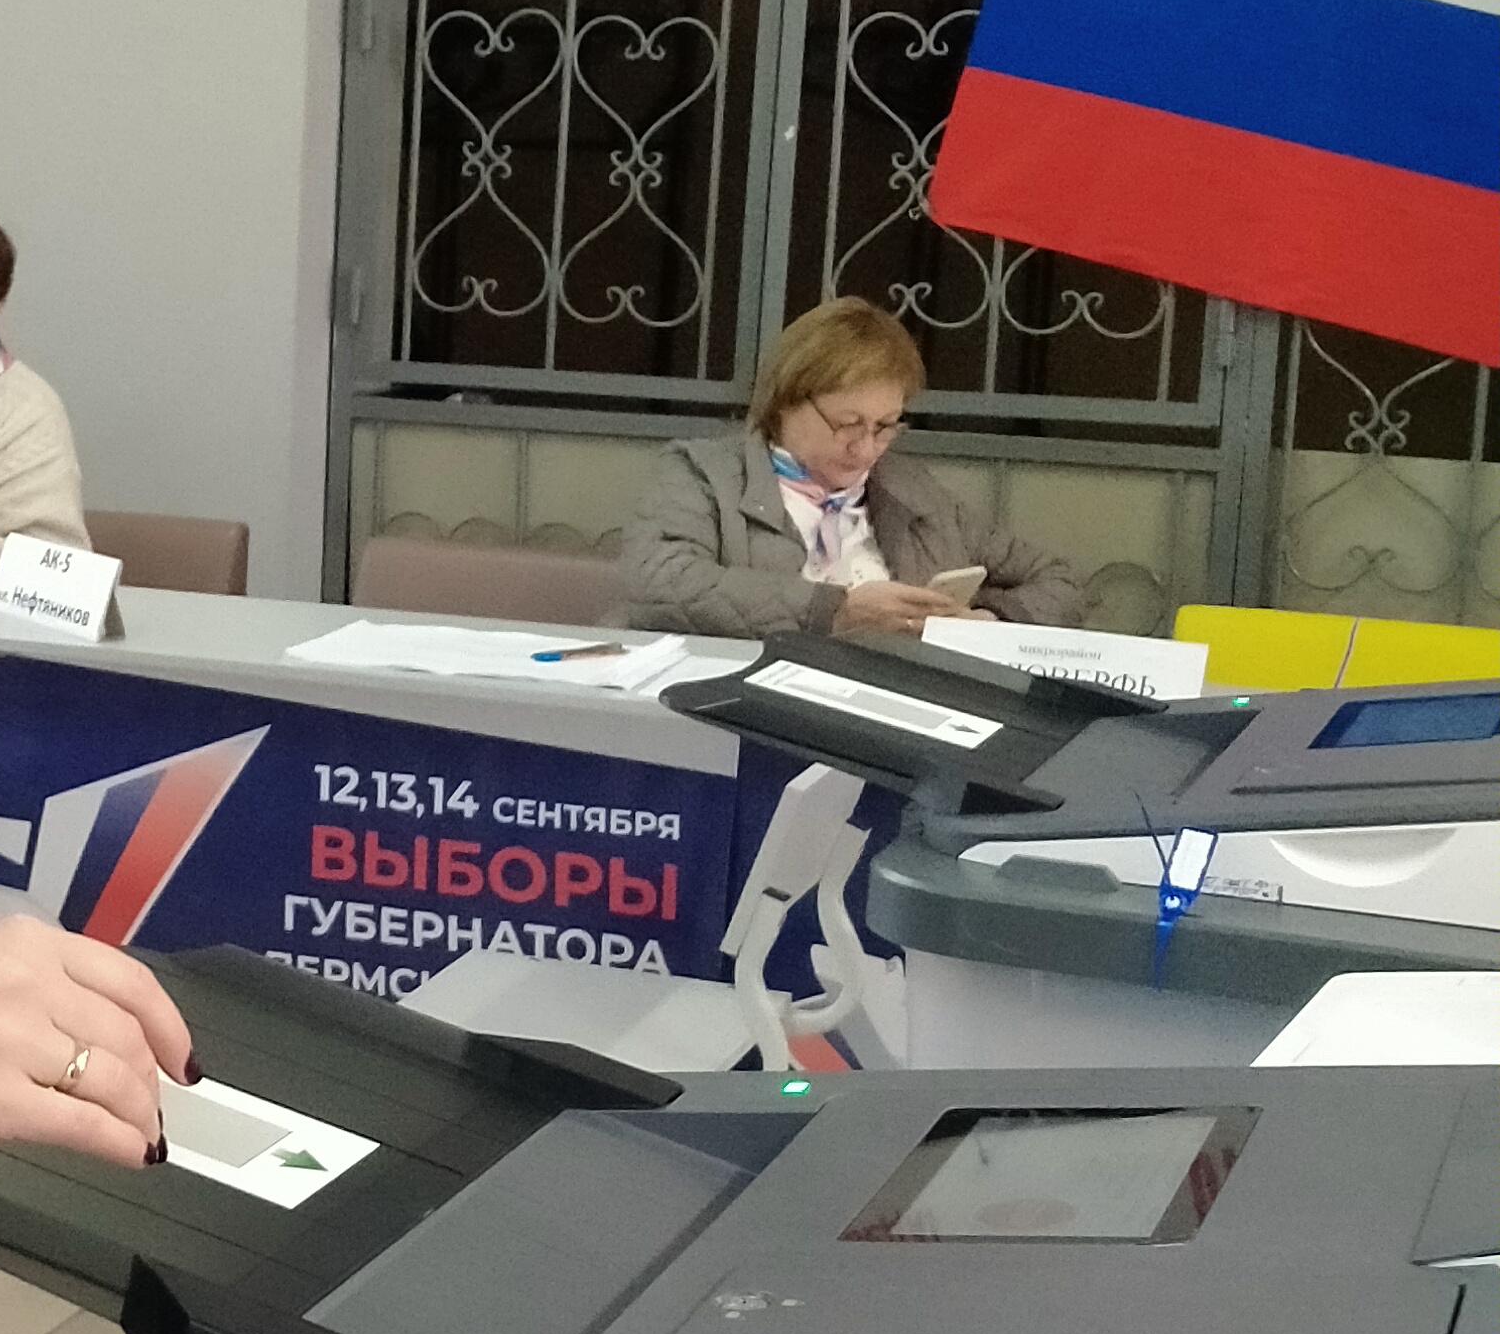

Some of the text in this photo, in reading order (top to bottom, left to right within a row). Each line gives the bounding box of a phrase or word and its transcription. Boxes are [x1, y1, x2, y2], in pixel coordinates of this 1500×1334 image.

[12, 586, 90, 626] Нефтяников
[313, 763, 680, 841] 12,13,14 СЕНТЯБРЯ
[311, 824, 679, 921] ВЫБОРЫ
[284, 894, 672, 977] ГУБЕРНАТОРА
